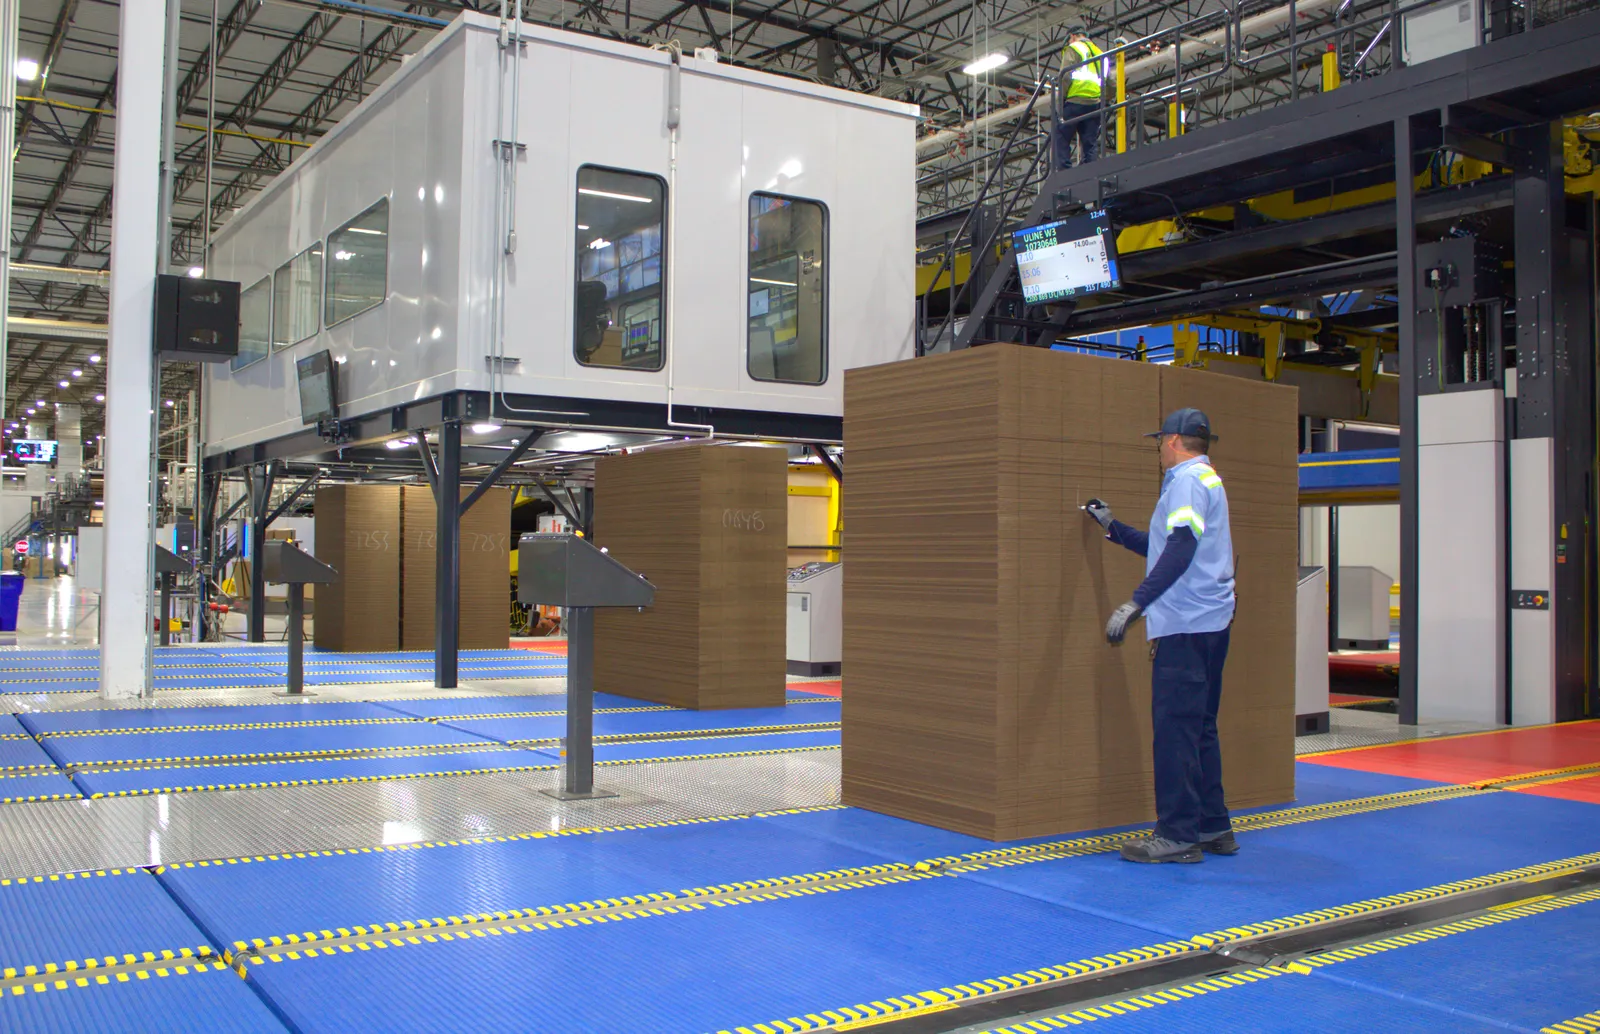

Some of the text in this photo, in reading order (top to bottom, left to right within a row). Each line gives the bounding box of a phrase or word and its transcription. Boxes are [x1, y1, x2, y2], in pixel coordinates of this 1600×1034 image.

[1090, 209, 1106, 219] 12:44
[1023, 228, 1057, 243] ULINE W3
[1025, 237, 1058, 251] 10730648
